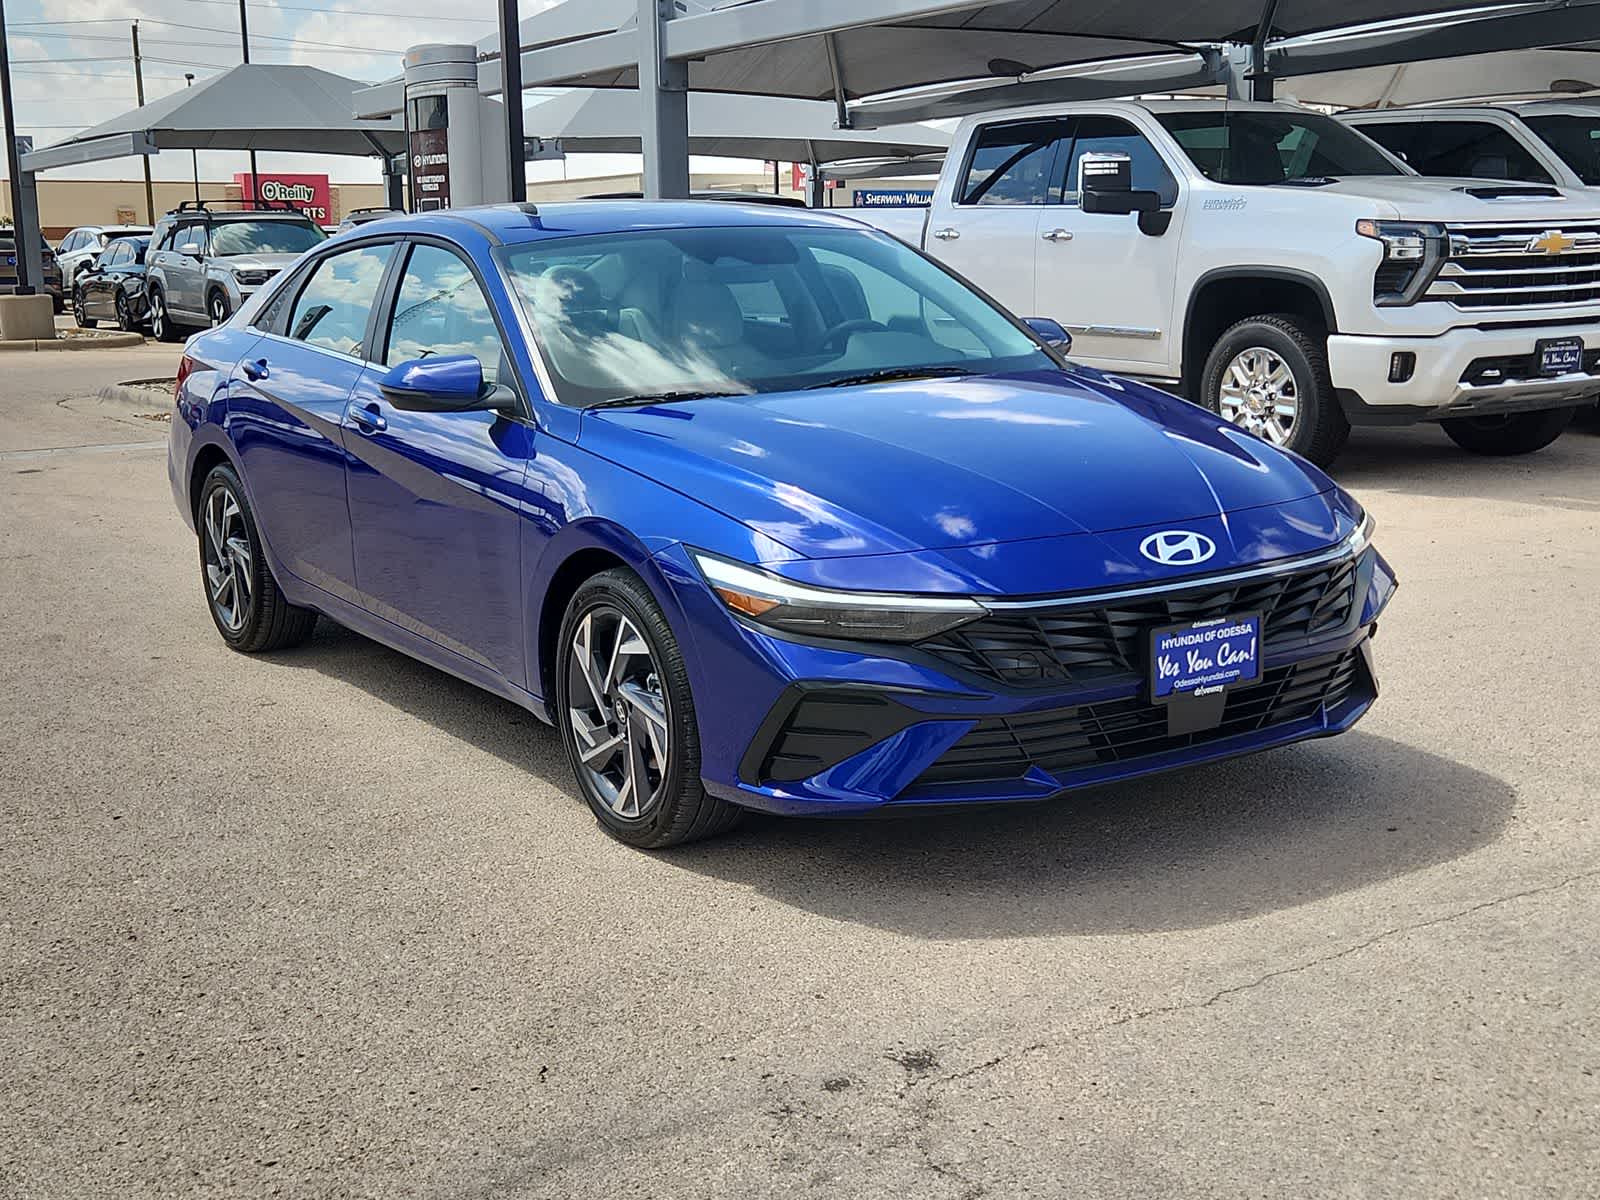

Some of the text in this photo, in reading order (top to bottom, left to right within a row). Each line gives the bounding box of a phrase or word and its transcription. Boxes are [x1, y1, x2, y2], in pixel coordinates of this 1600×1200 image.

[261, 181, 315, 203] O'Reilly
[865, 193, 932, 205] SHERWIN-WILLIA
[1161, 624, 1253, 650] HYUNDAI OF ODESSA
[1157, 636, 1257, 680] Yes You Can!
[1173, 669, 1240, 689] OdessaHyundai.com
